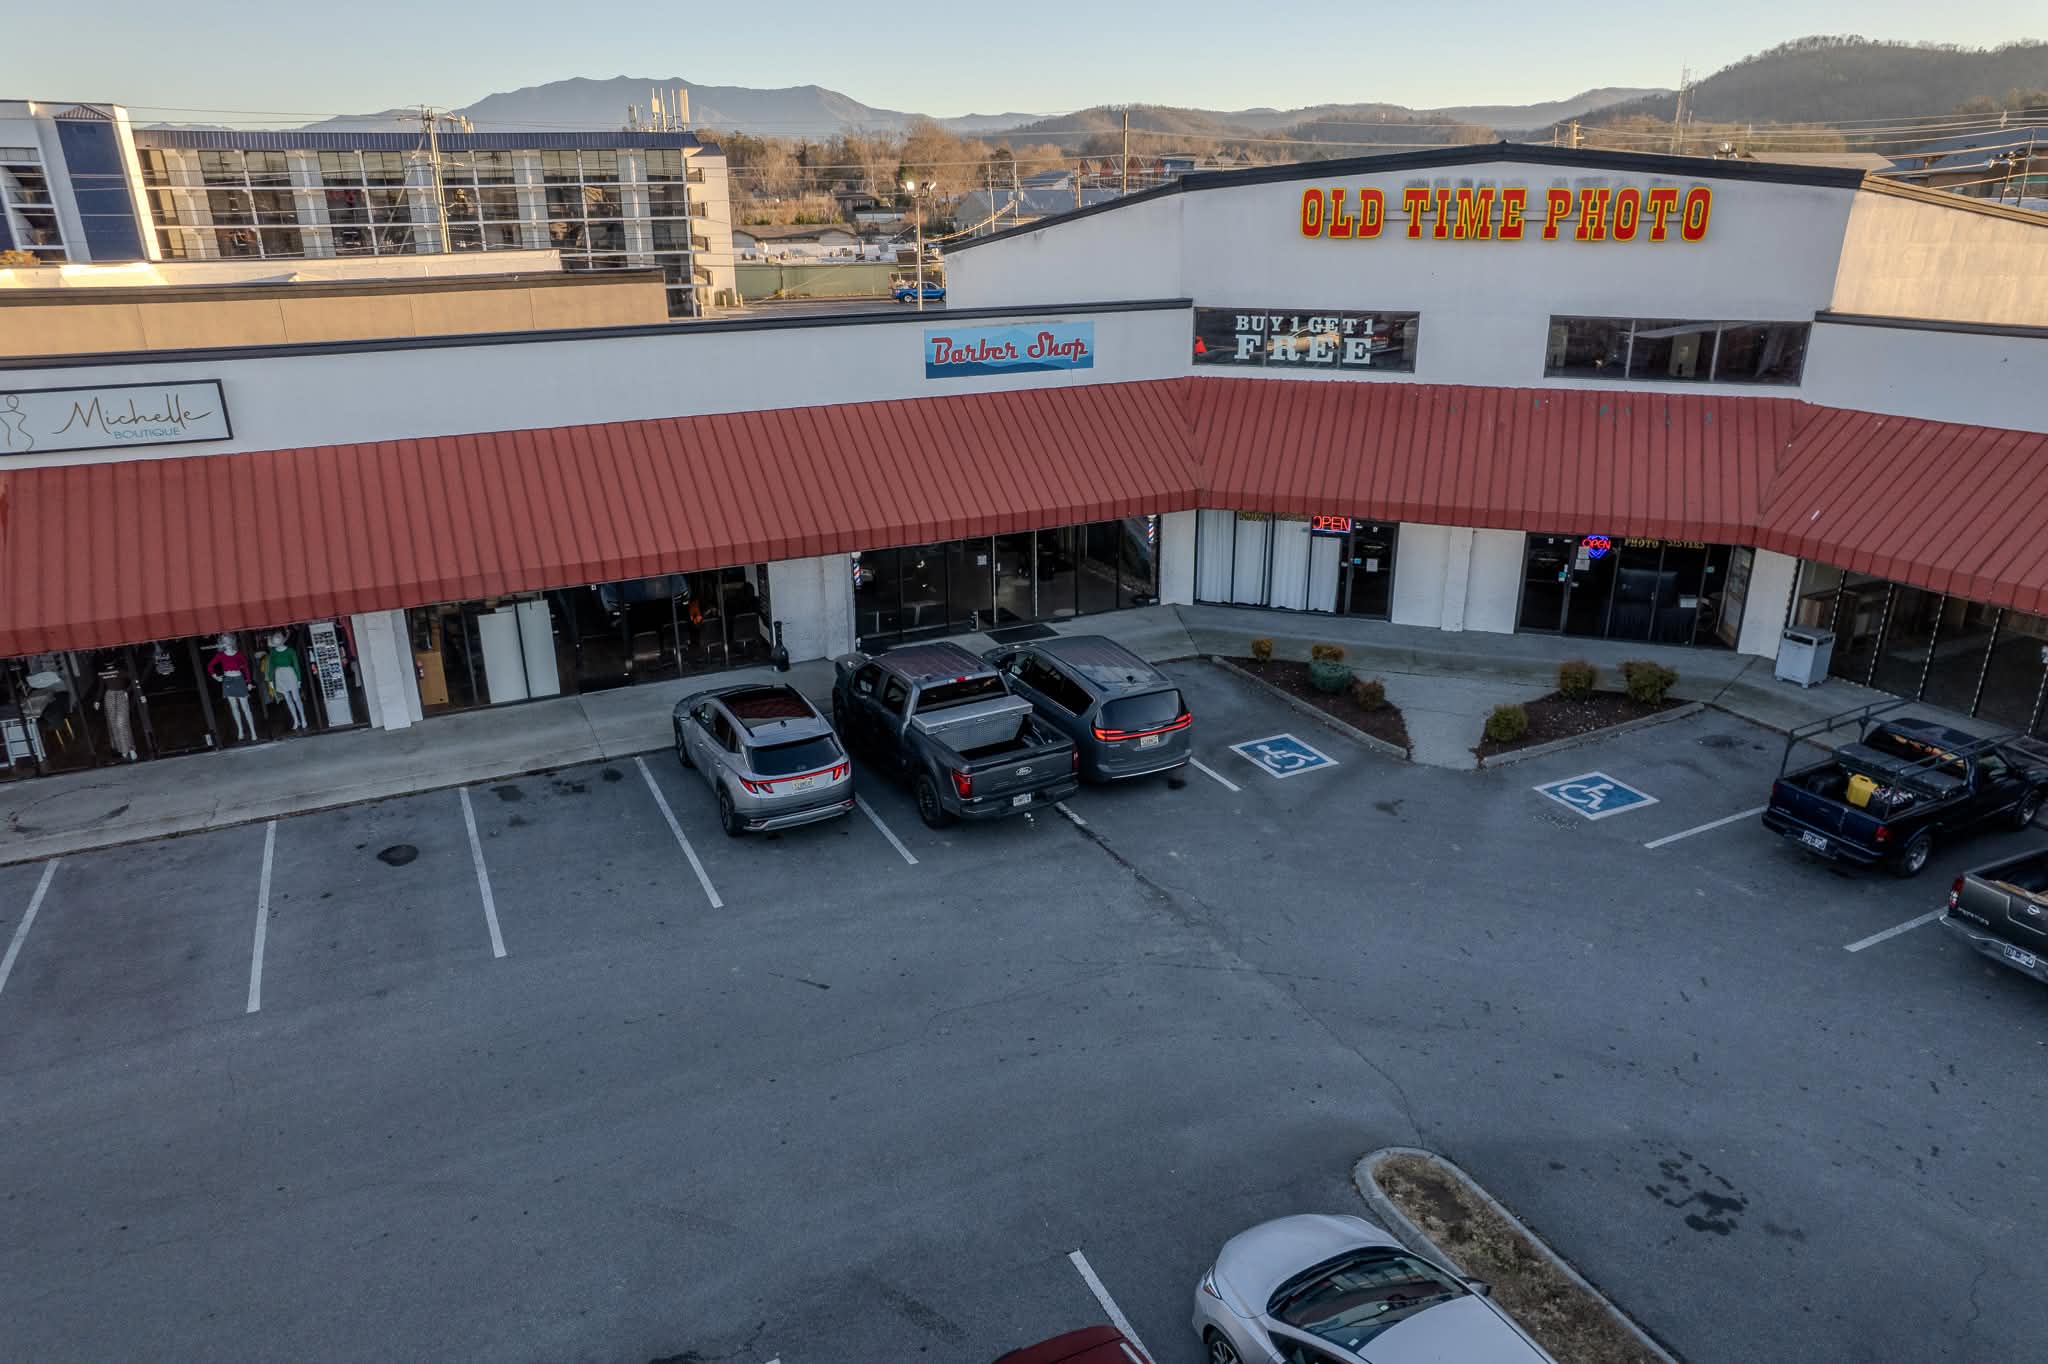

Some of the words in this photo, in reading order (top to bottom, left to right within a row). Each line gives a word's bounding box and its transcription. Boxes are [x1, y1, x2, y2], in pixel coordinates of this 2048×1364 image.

[1301, 187, 1385, 239] OLD
[1403, 188, 1527, 240] TIME
[1543, 187, 1713, 242] PHOTO
[1235, 315, 1283, 331] BUY
[1290, 317, 1299, 332] 1
[1308, 317, 1357, 334] GET
[1364, 319, 1374, 335] 1
[931, 336, 1018, 365] Barber
[1027, 331, 1089, 362] Shop
[1234, 334, 1372, 364] FREE
[52, 393, 213, 435] Michelle
[113, 426, 181, 440] BOUTIQUE
[1312, 515, 1351, 532] OPEN
[1582, 538, 1611, 550] OPEN
[1623, 537, 1659, 549] PHOTO
